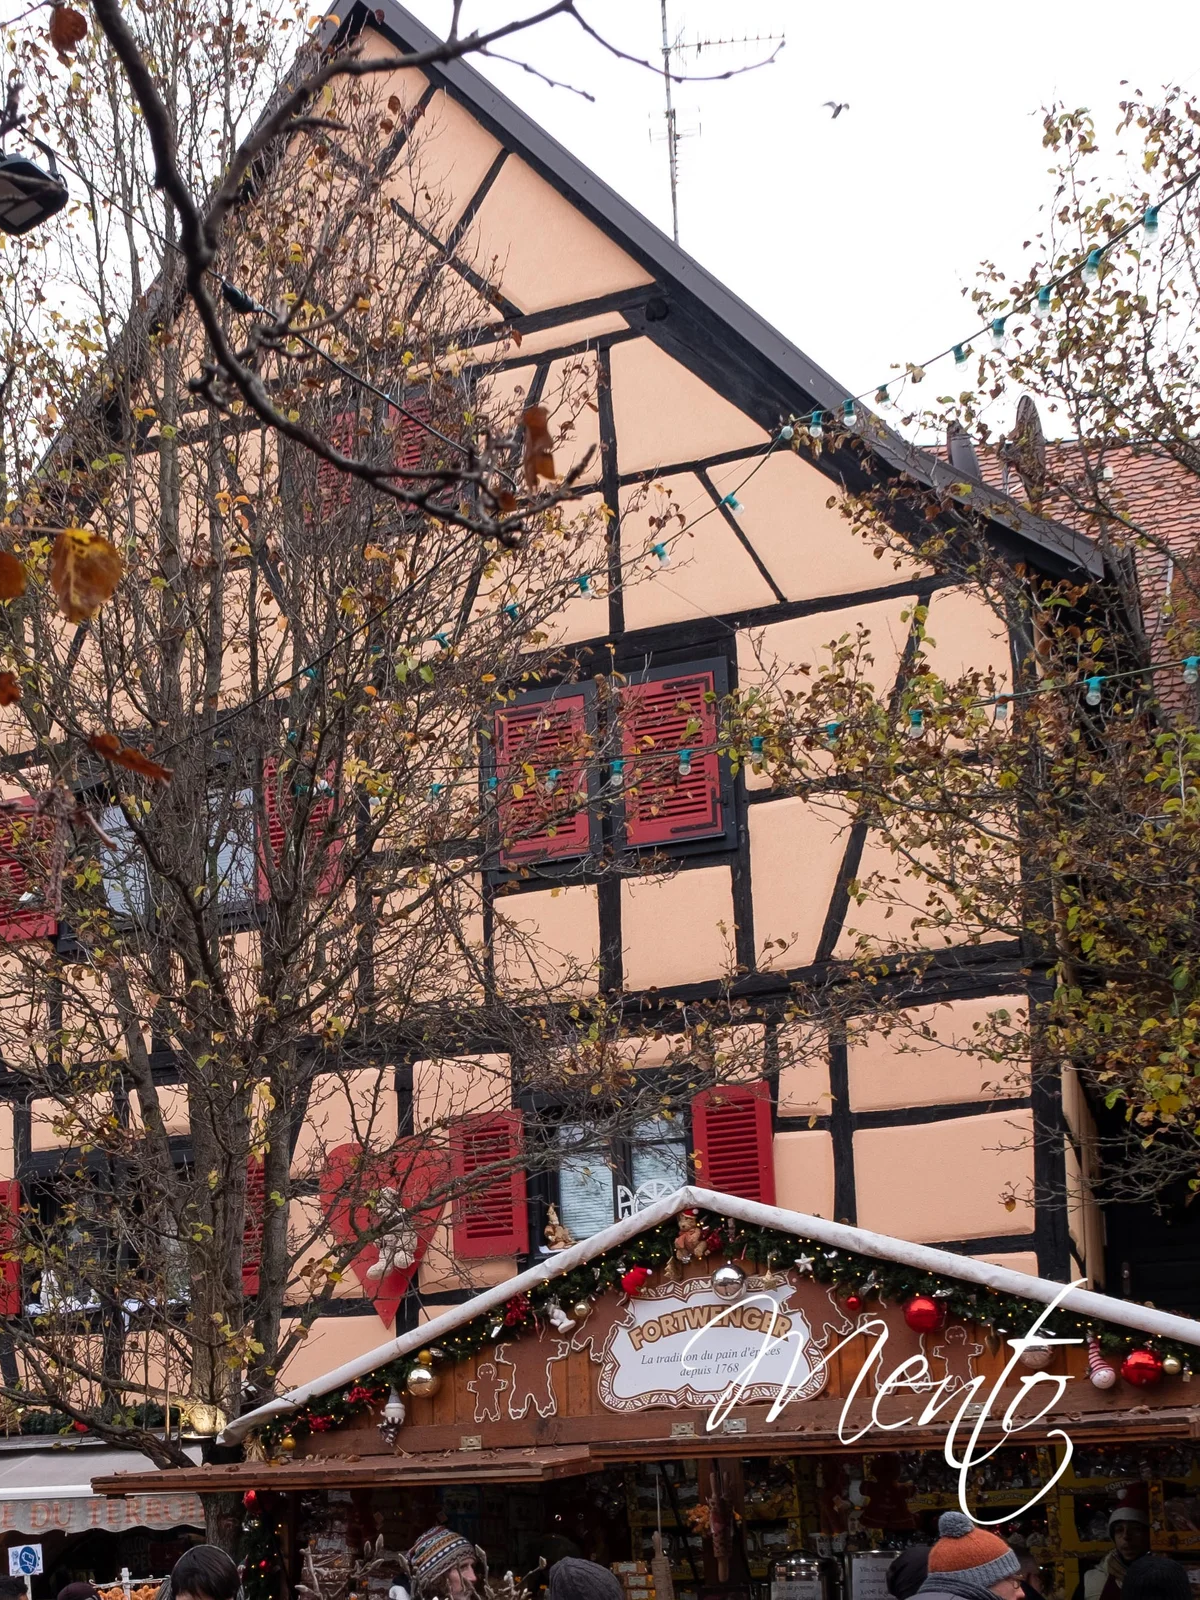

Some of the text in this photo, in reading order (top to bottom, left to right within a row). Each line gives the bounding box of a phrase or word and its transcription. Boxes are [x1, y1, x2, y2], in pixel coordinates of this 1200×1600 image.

[627, 1304, 792, 1352] FORTWENGER
[641, 1354, 654, 1365] La
[700, 1349, 714, 1361] du
[714, 1348, 738, 1362] pain
[740, 1346, 781, 1360] d'épces
[679, 1362, 740, 1378] depuis 1768
[30, 1502, 72, 1529] DU
[86, 1496, 205, 1526] TERROI
